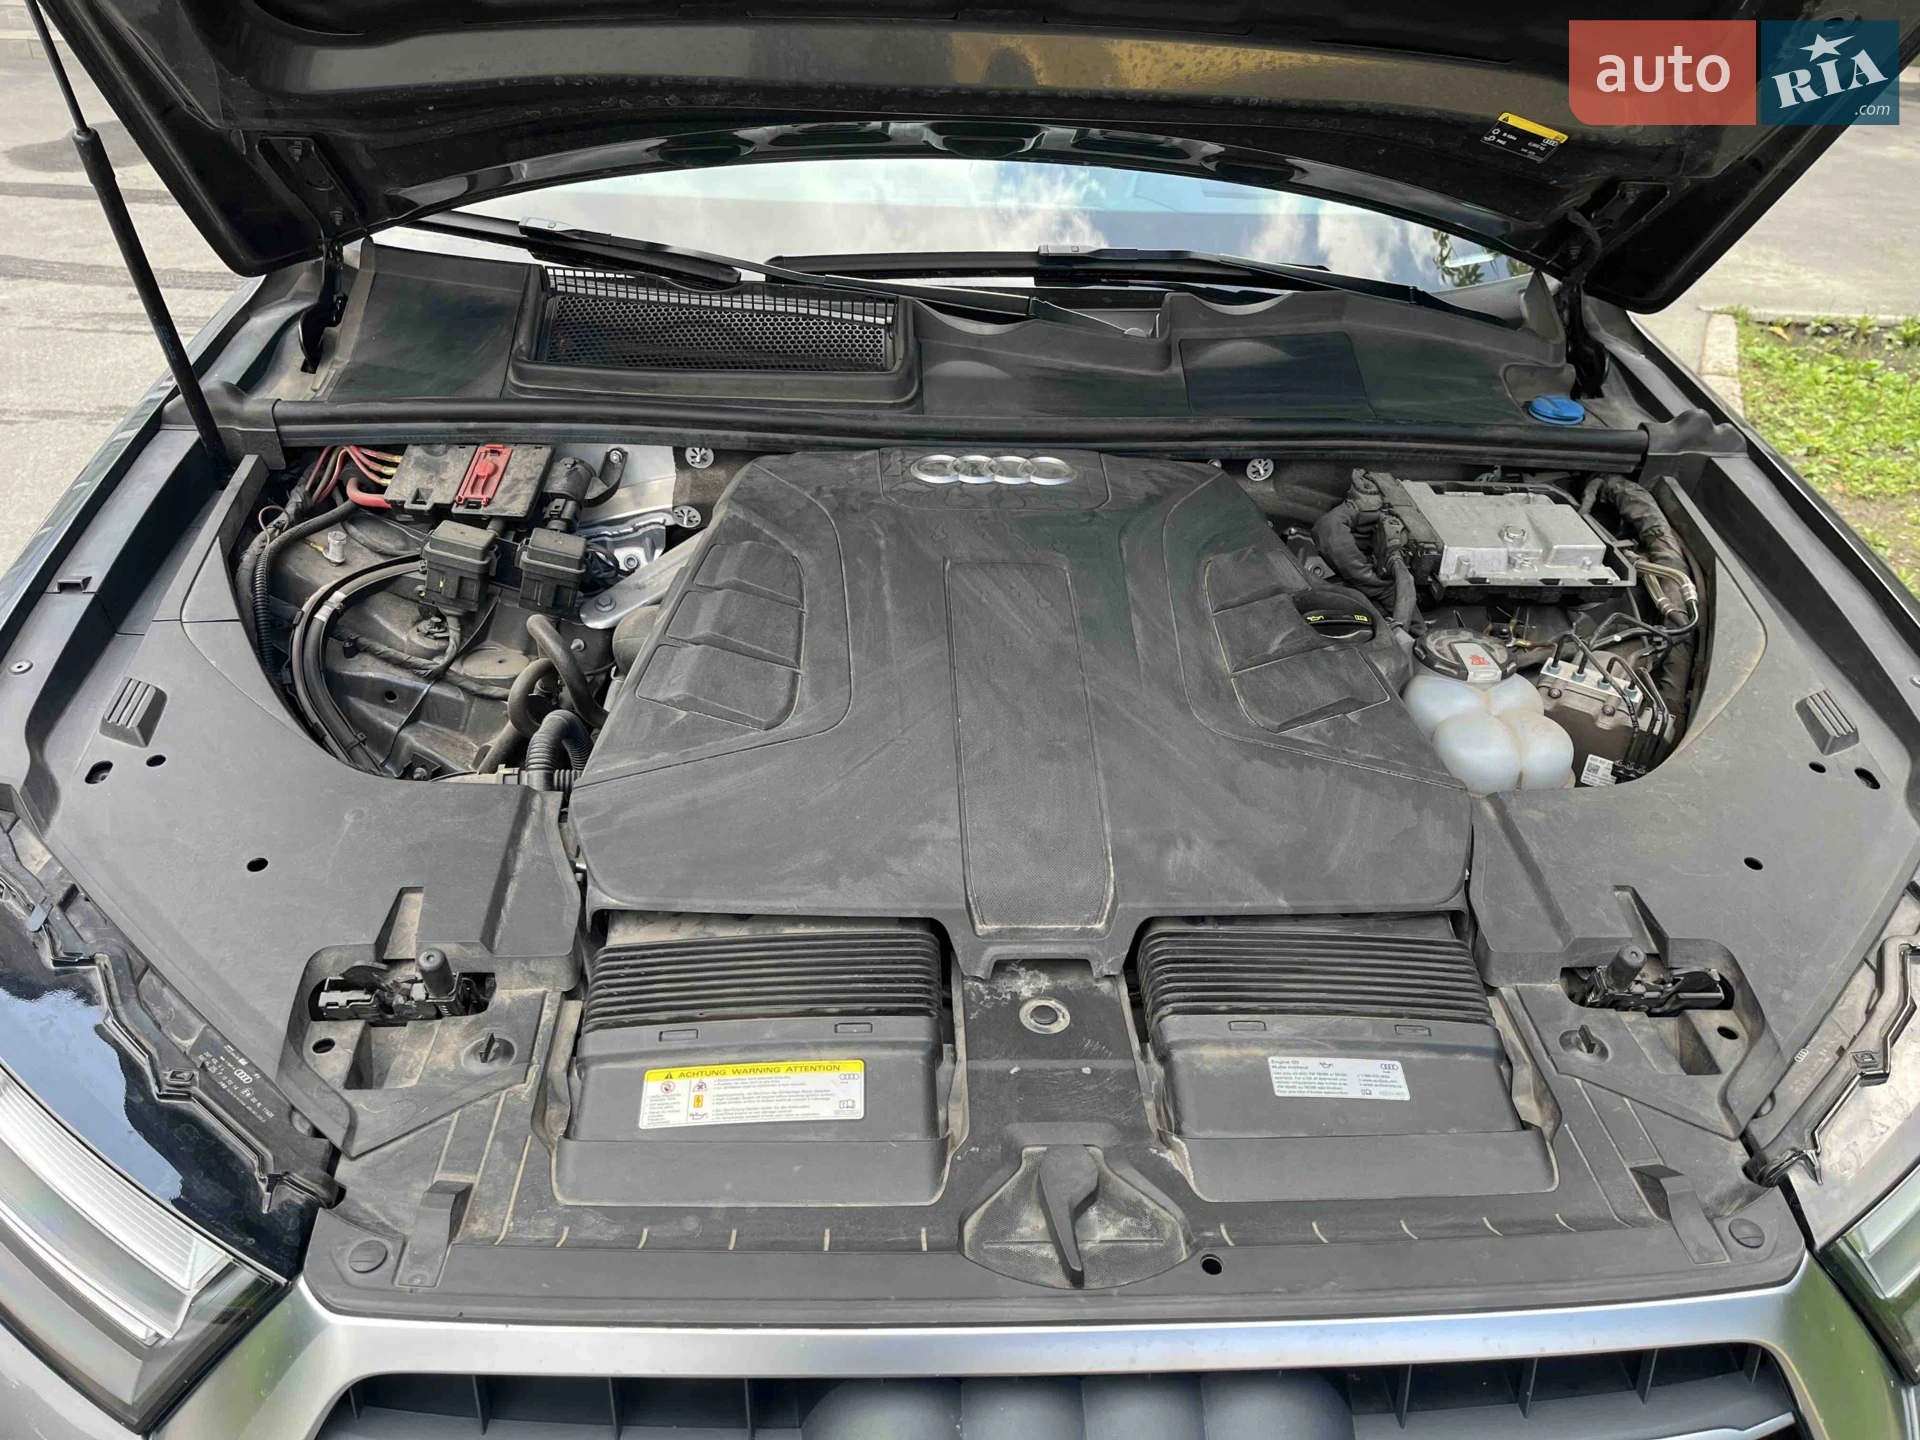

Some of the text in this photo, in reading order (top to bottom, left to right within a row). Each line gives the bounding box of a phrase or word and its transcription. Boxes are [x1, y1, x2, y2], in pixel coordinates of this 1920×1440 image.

[678, 1064, 841, 1079] ACHTUNG WARNING ATTENTION
